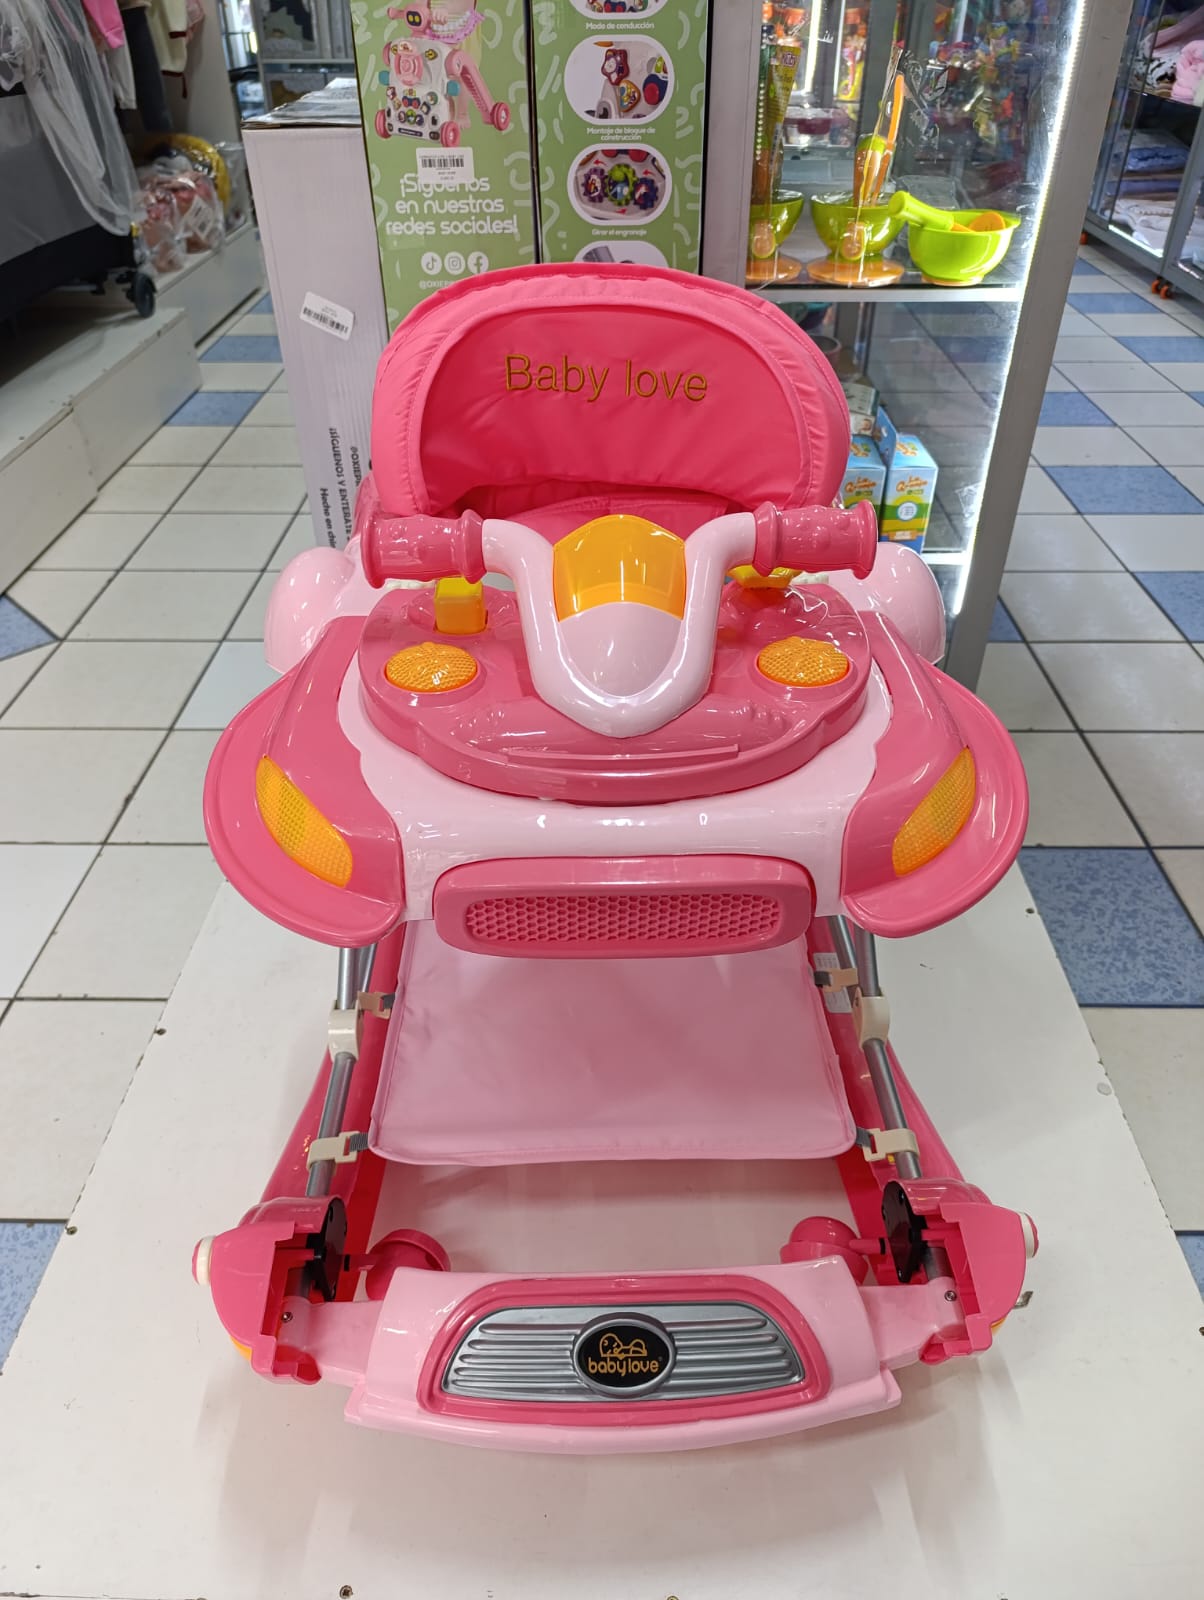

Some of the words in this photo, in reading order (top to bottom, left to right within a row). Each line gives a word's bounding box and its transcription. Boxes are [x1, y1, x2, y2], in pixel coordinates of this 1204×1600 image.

[395, 200, 419, 214] en
[424, 195, 505, 214] nuestras
[386, 216, 436, 235] redes
[440, 214, 518, 235] sociales!
[505, 353, 610, 403] Baby
[625, 359, 708, 401] love
